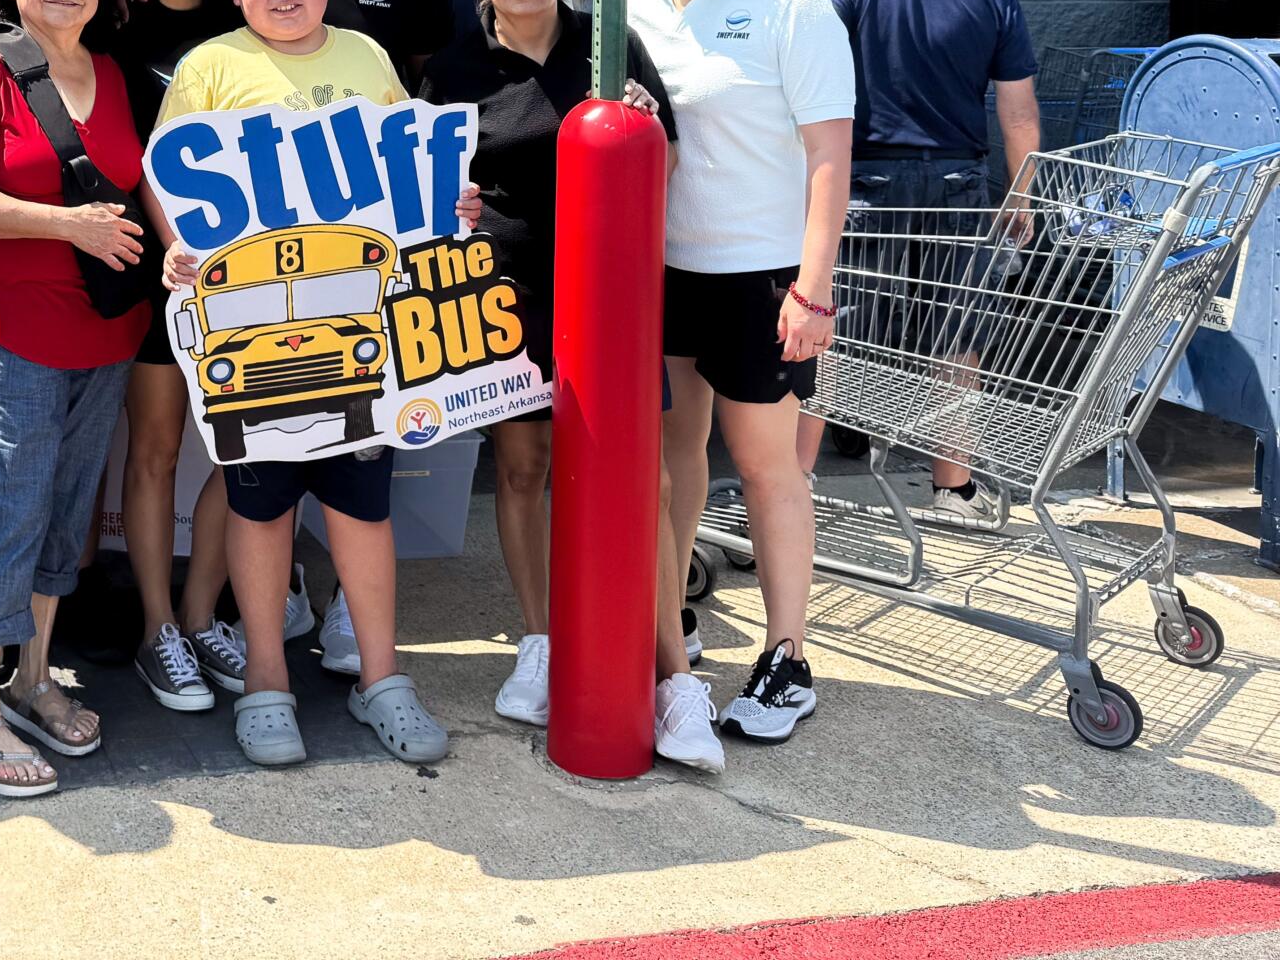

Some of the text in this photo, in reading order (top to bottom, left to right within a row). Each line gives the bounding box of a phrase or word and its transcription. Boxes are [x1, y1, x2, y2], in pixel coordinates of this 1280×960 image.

[716, 31, 751, 40] SWEPT AWAY
[311, 83, 334, 107] OF
[151, 105, 468, 250] Stuff
[279, 240, 301, 274] 8
[408, 241, 494, 291] The
[444, 371, 532, 413] UNITED WAY
[448, 391, 553, 429] Northeast Arkansa
